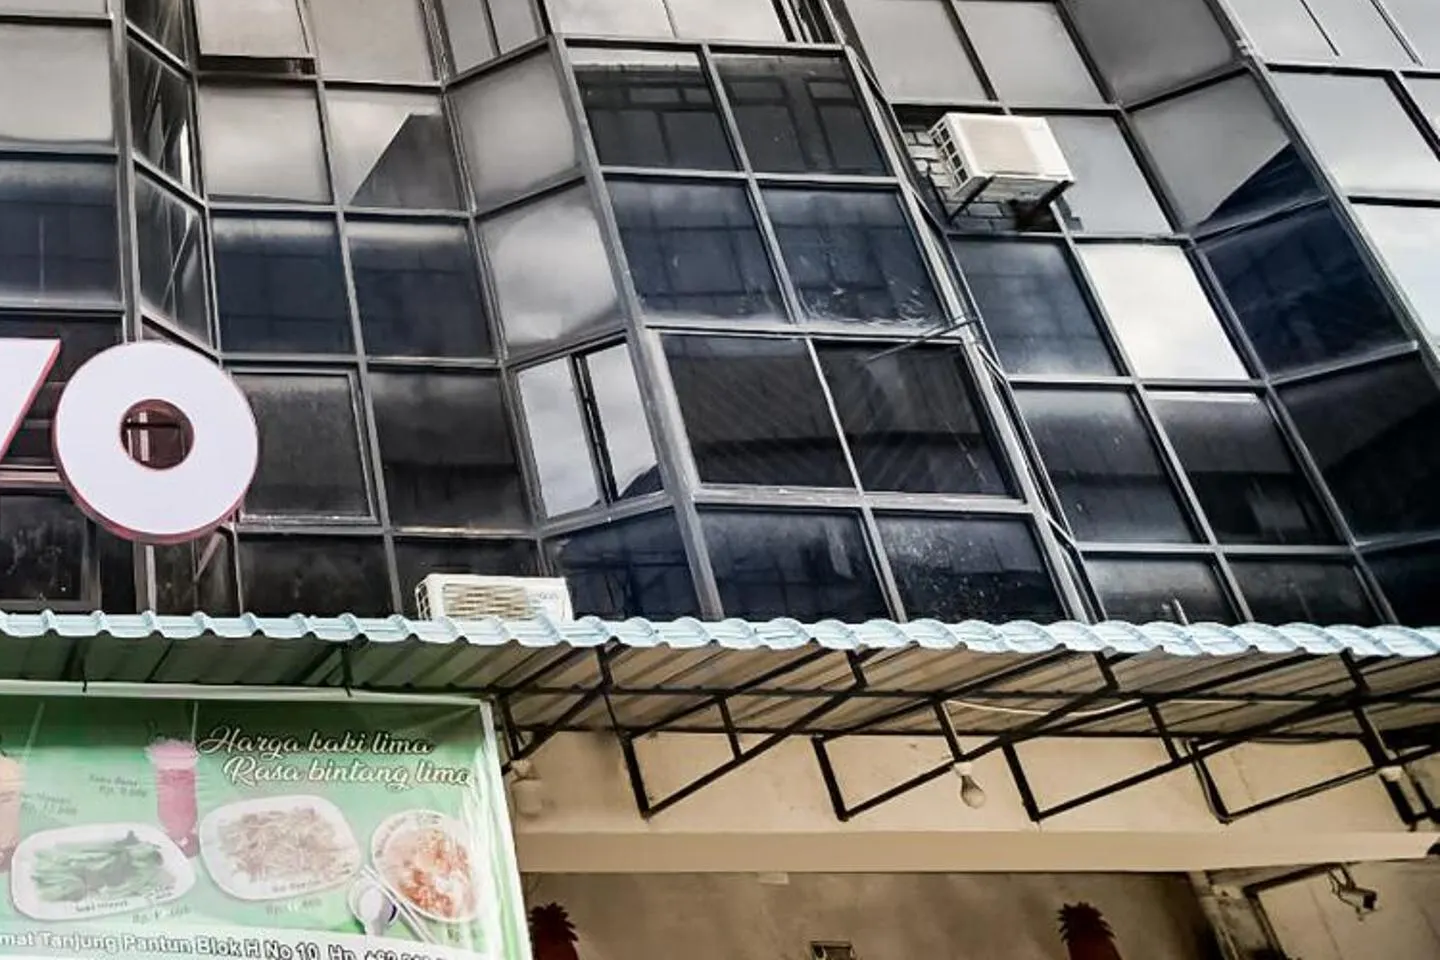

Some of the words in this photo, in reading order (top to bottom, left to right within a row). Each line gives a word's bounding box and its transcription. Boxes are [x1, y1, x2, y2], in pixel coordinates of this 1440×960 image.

[198, 725, 301, 760] Harga
[307, 730, 366, 755] kaki
[371, 732, 434, 755] lima
[222, 755, 301, 787] Rasa
[308, 758, 410, 790] bintang
[415, 761, 475, 787] lima
[39, 931, 118, 954] Tanjung
[123, 935, 192, 953] Pantun
[197, 936, 244, 959] Blok
[244, 938, 261, 958] H
